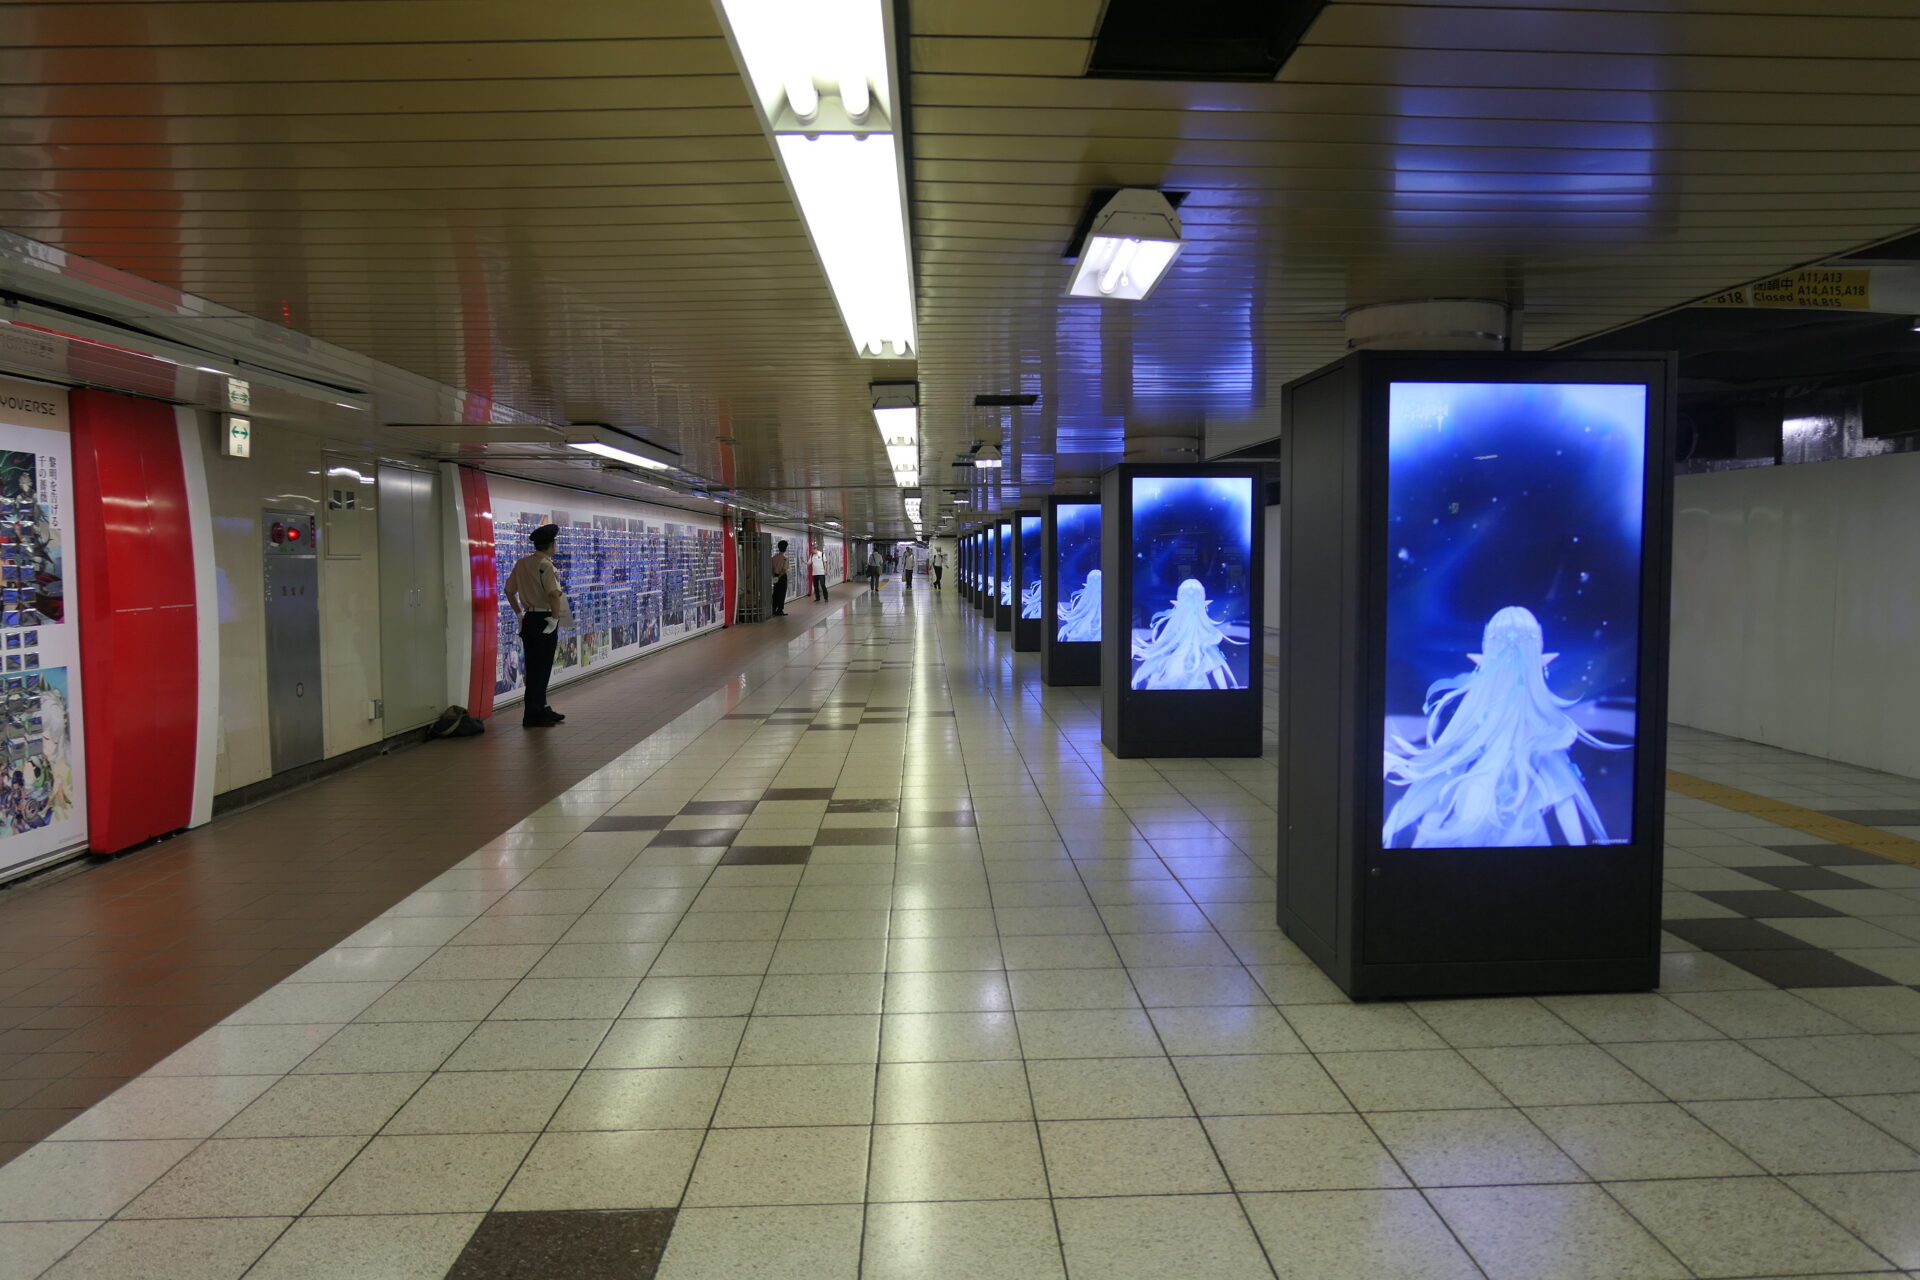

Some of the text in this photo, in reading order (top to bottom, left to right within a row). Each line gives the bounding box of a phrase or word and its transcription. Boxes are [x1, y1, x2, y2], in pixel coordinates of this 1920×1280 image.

[1798, 272, 1843, 284] A11,A13
[1797, 285, 1865, 296] A14,A15,A18
[1753, 292, 1794, 302] Closed
